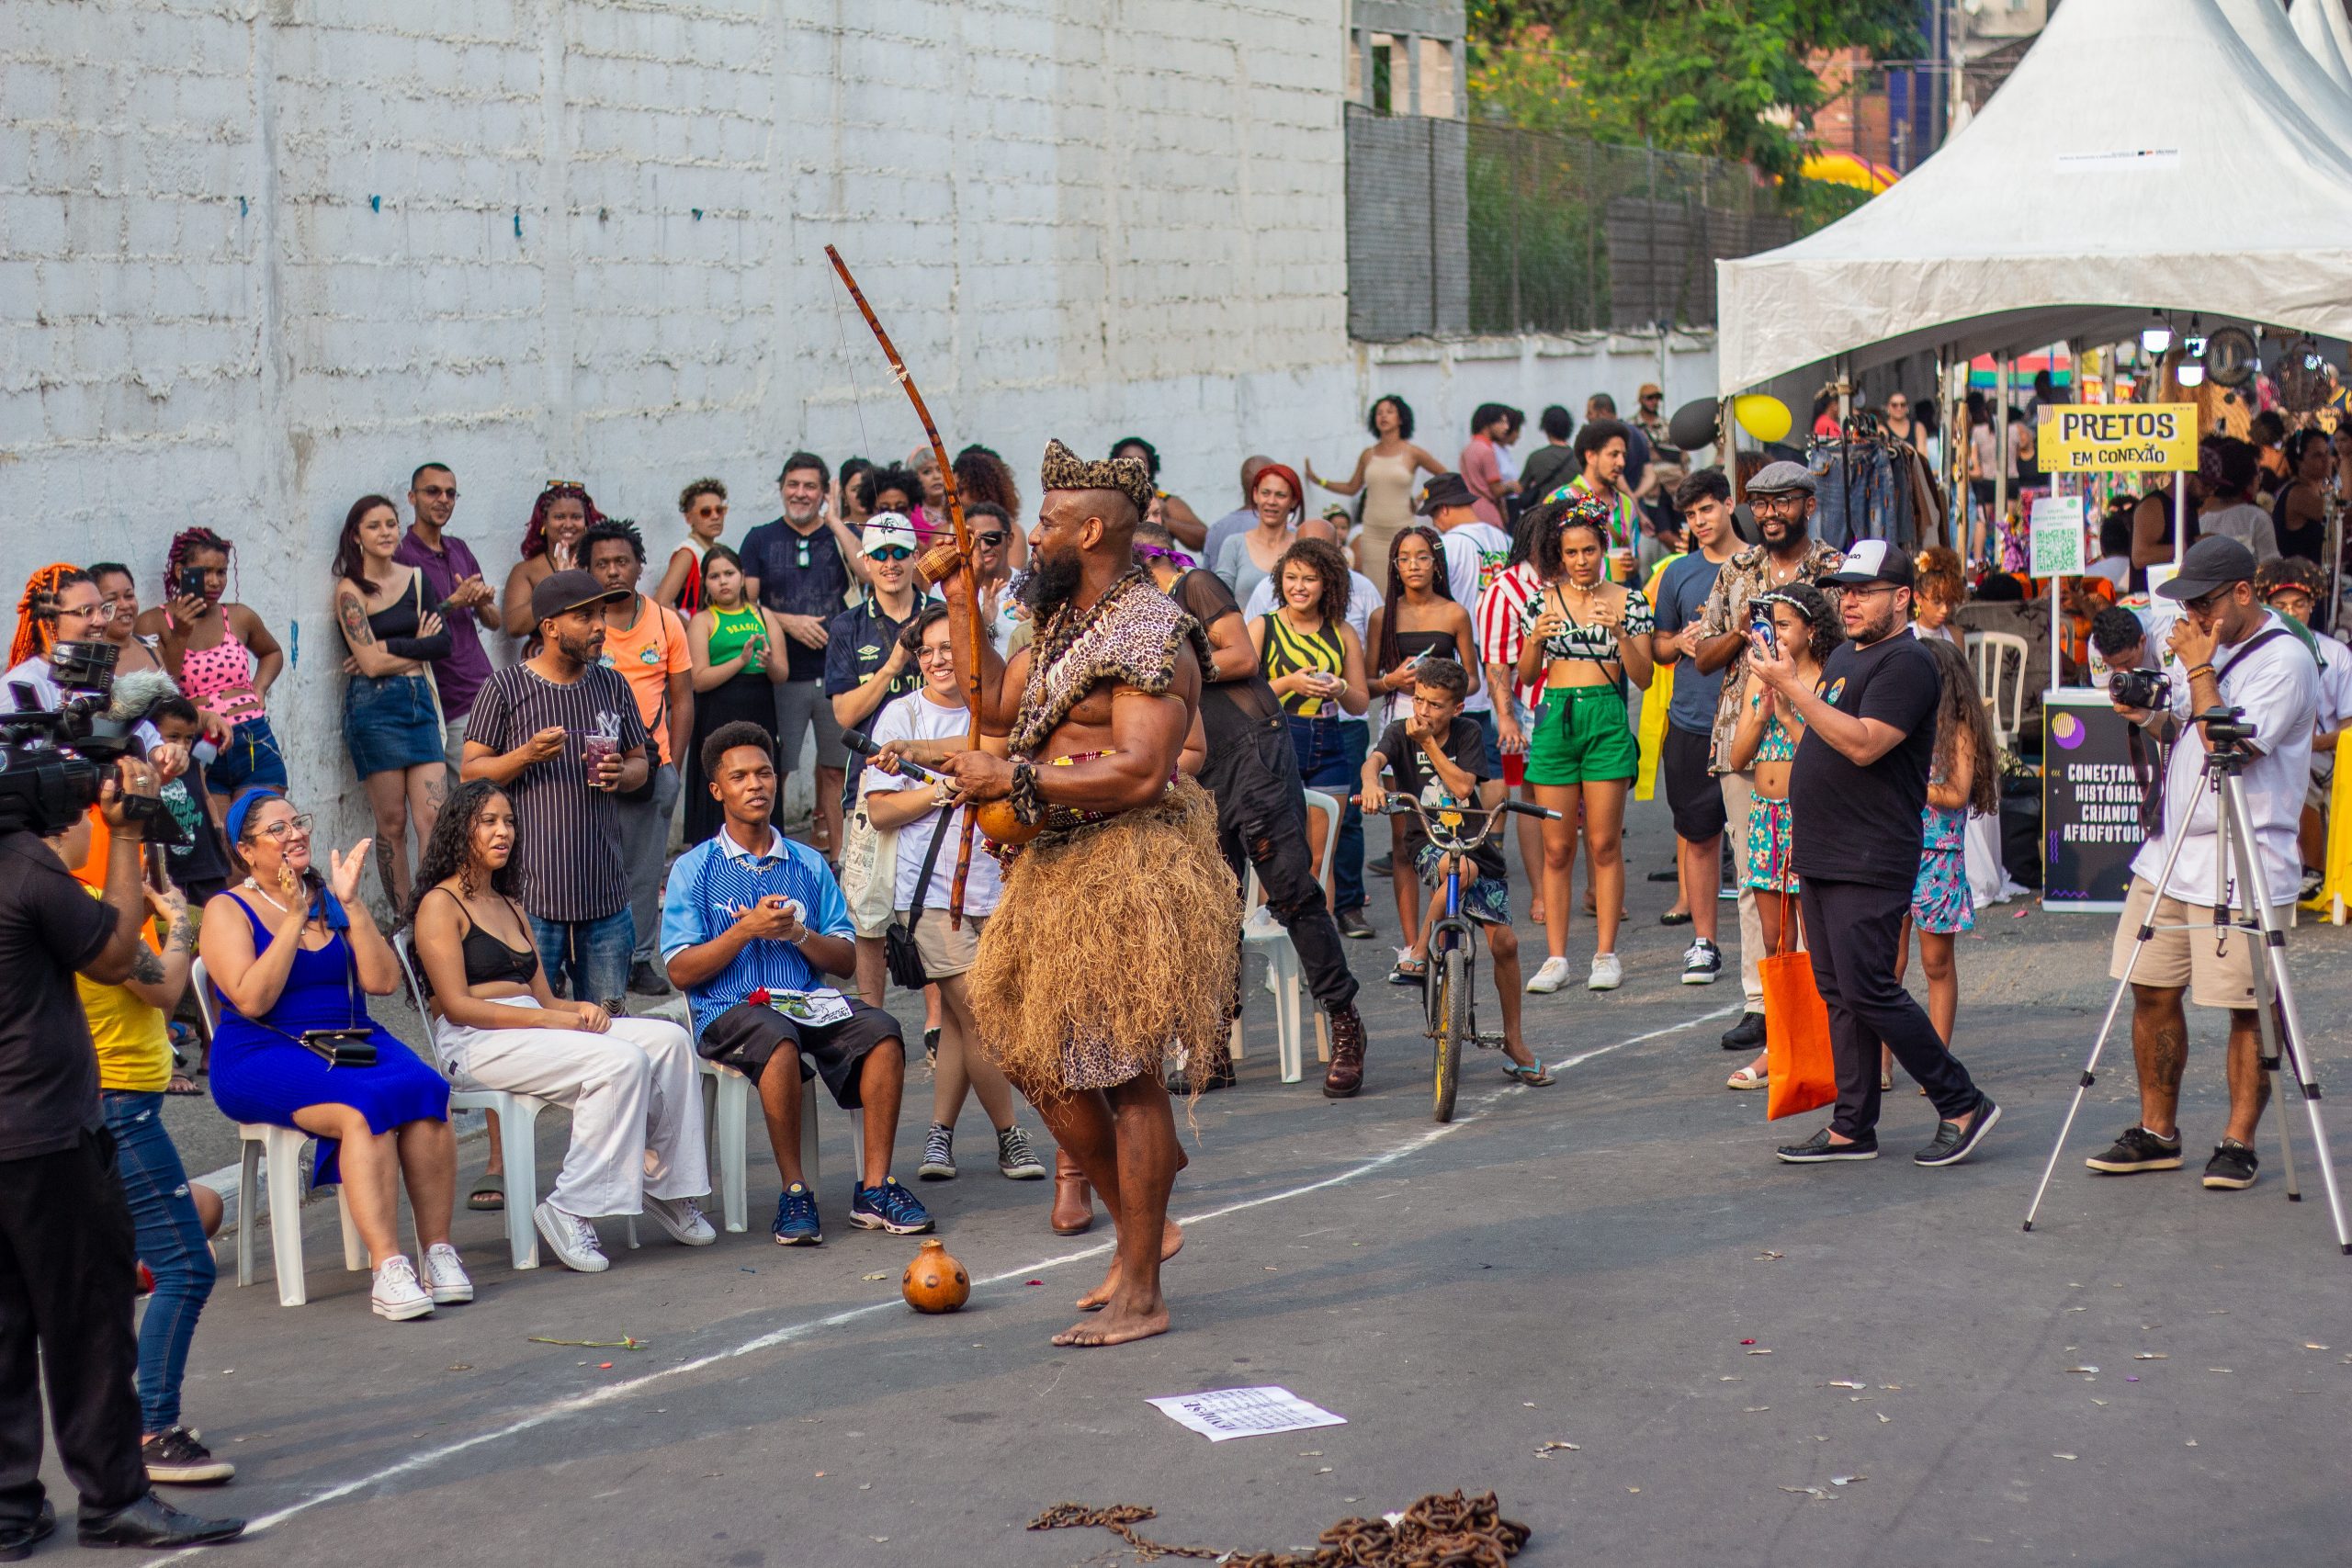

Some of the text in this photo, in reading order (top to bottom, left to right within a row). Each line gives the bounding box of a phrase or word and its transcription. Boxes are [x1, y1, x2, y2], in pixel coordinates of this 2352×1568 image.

[2064, 412, 2175, 442] PRETOS
[2072, 443, 2165, 467] EM CONEXÃO
[726, 623, 759, 634] BRASIL
[2067, 763, 2154, 783] CONECTANO
